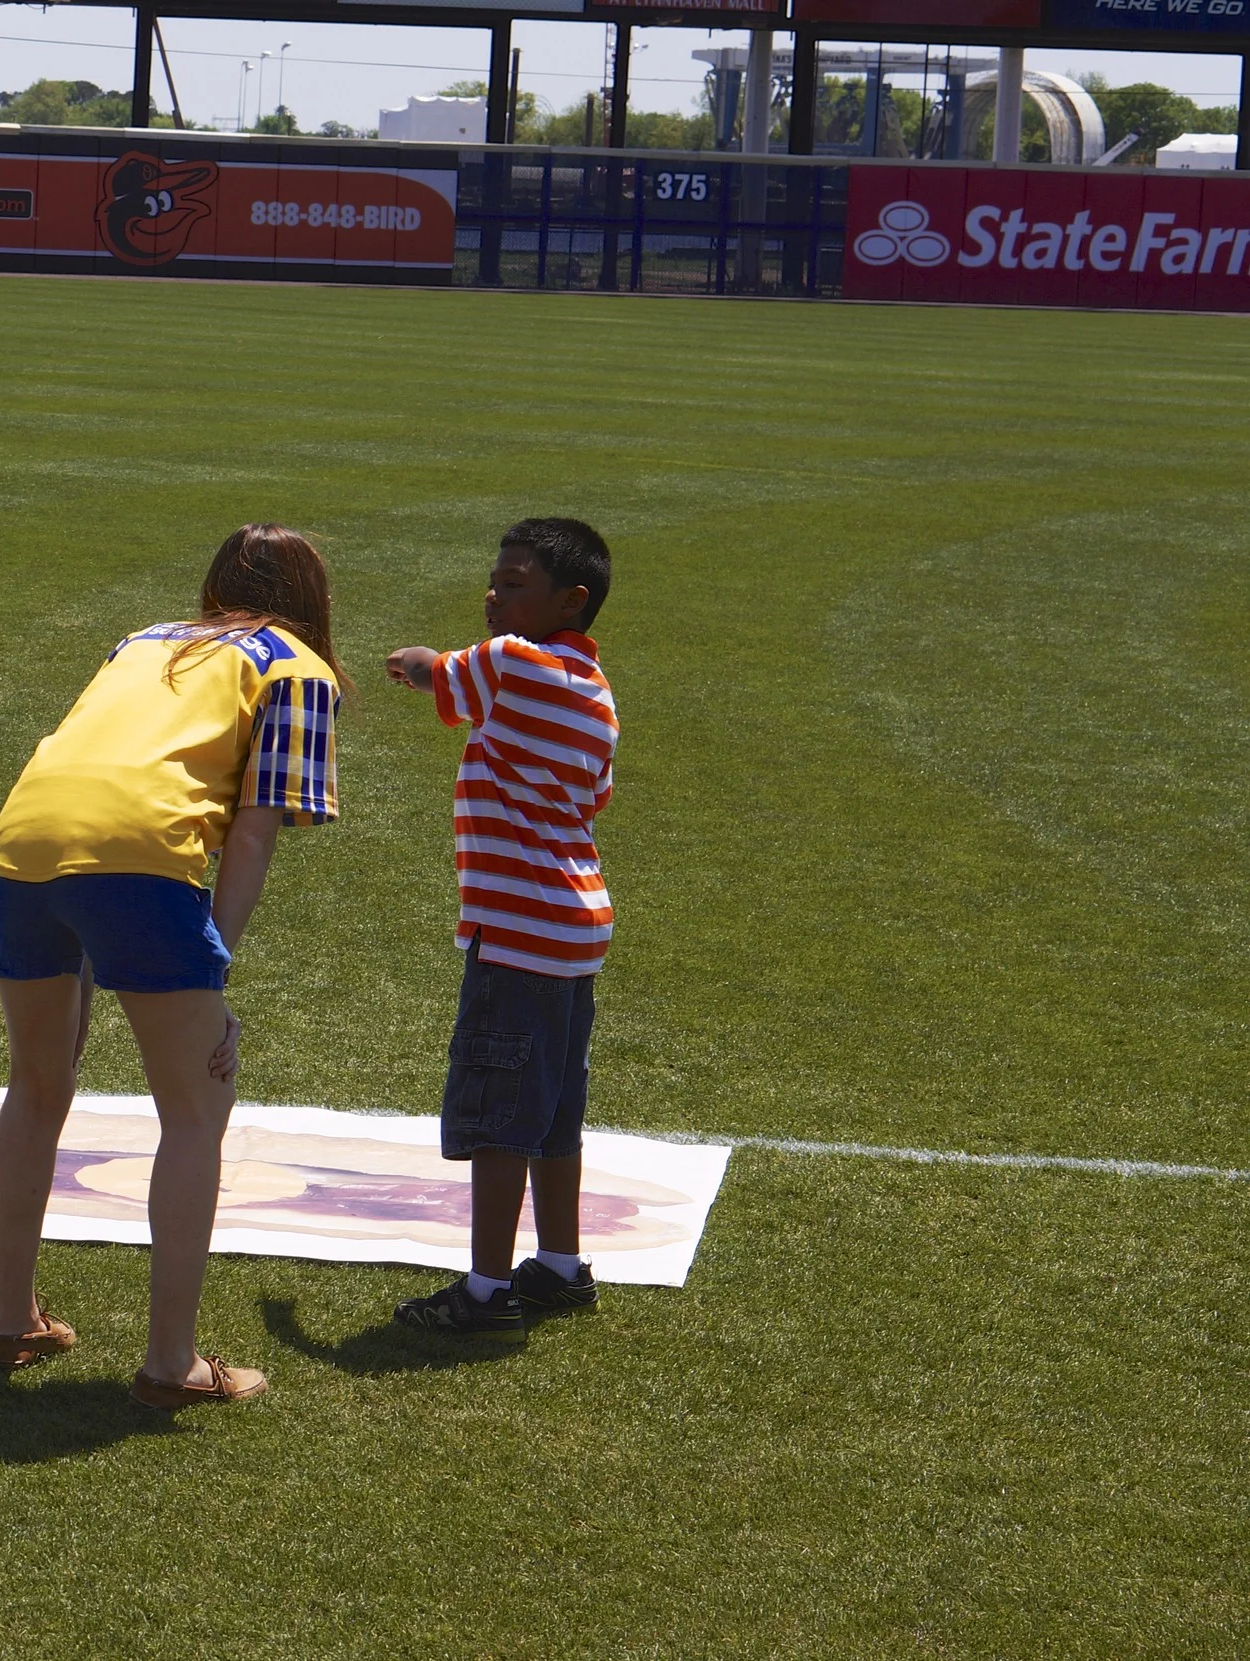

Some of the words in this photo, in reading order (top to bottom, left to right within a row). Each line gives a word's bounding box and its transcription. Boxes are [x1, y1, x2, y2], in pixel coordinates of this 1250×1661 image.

[728, 0, 764, 10] MALL
[1095, 0, 1161, 11] HERE
[1167, 0, 1202, 13] WE
[656, 172, 707, 201] 375
[250, 200, 421, 231] 888-848-BIRD
